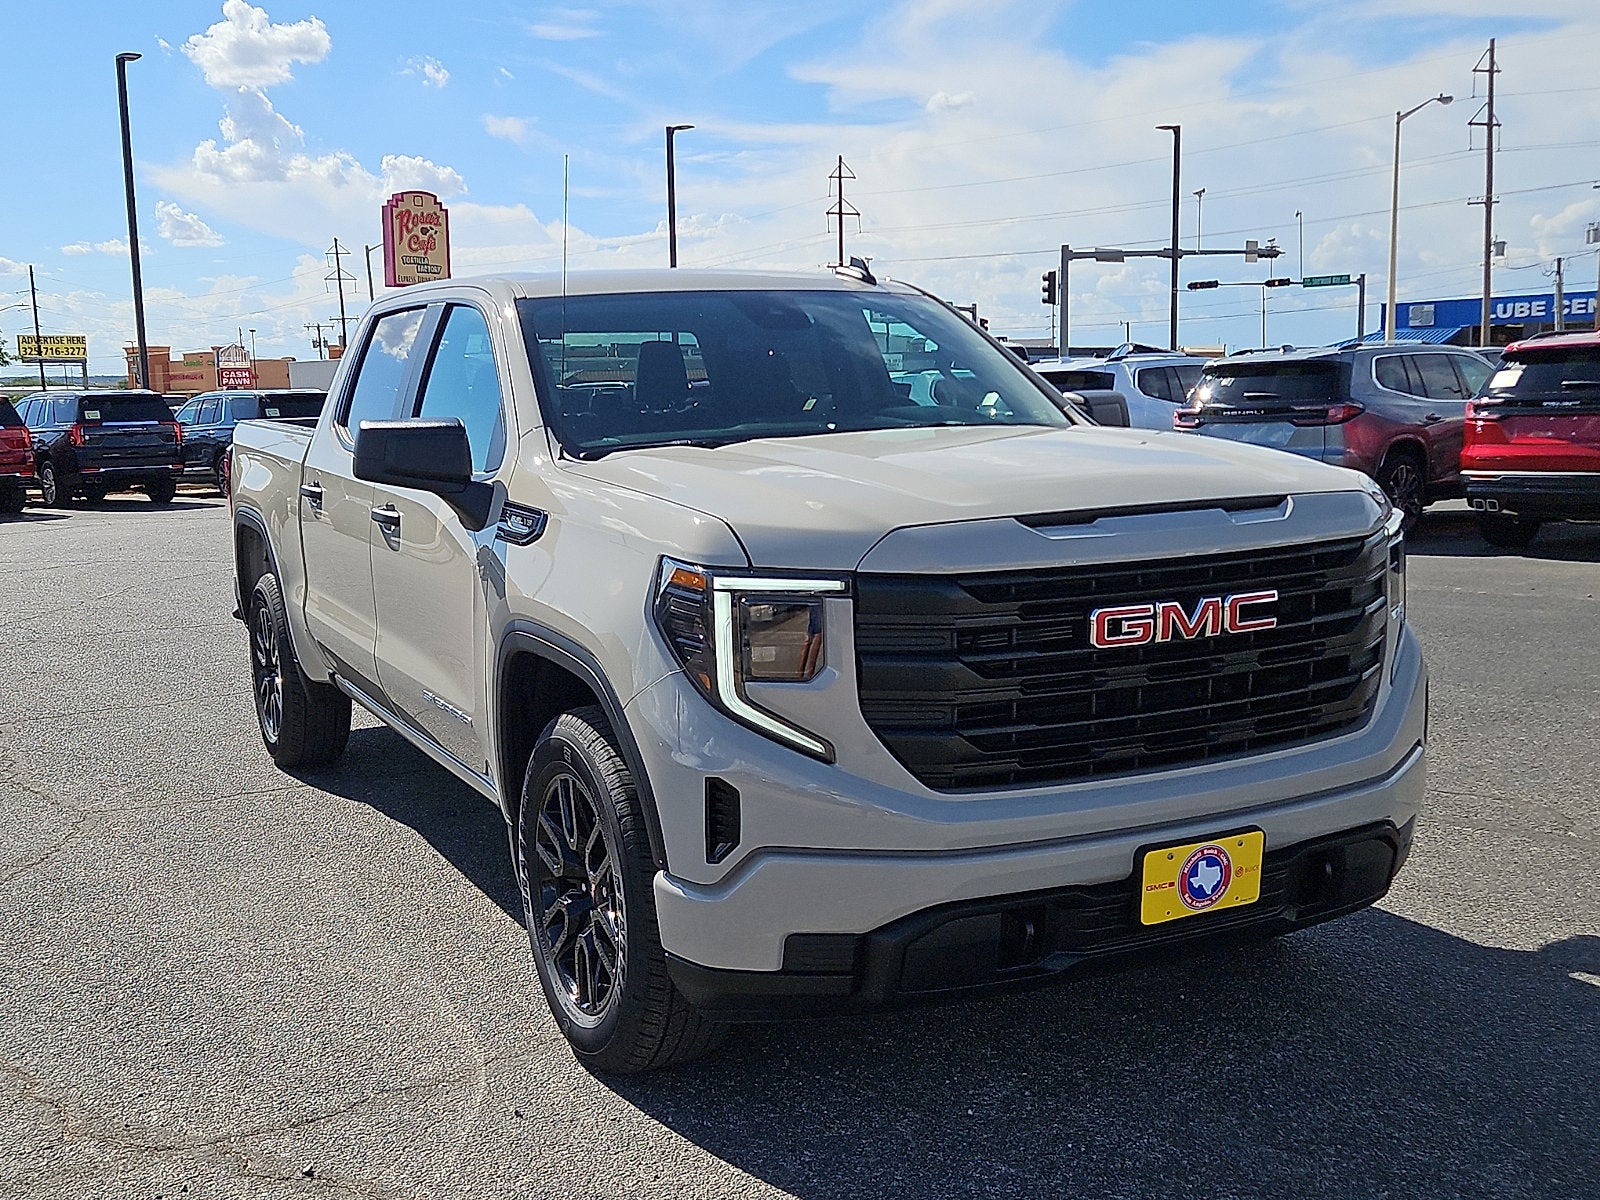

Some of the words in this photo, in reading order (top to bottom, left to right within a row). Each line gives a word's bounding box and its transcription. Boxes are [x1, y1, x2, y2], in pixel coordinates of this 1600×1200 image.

[402, 256, 428, 265] TORTILLA
[417, 265, 441, 273] FACTORY
[1490, 301, 1546, 319] UBE
[66, 336, 86, 345] HERE
[1090, 590, 1278, 648] GMC
[1145, 882, 1168, 892] GMC
